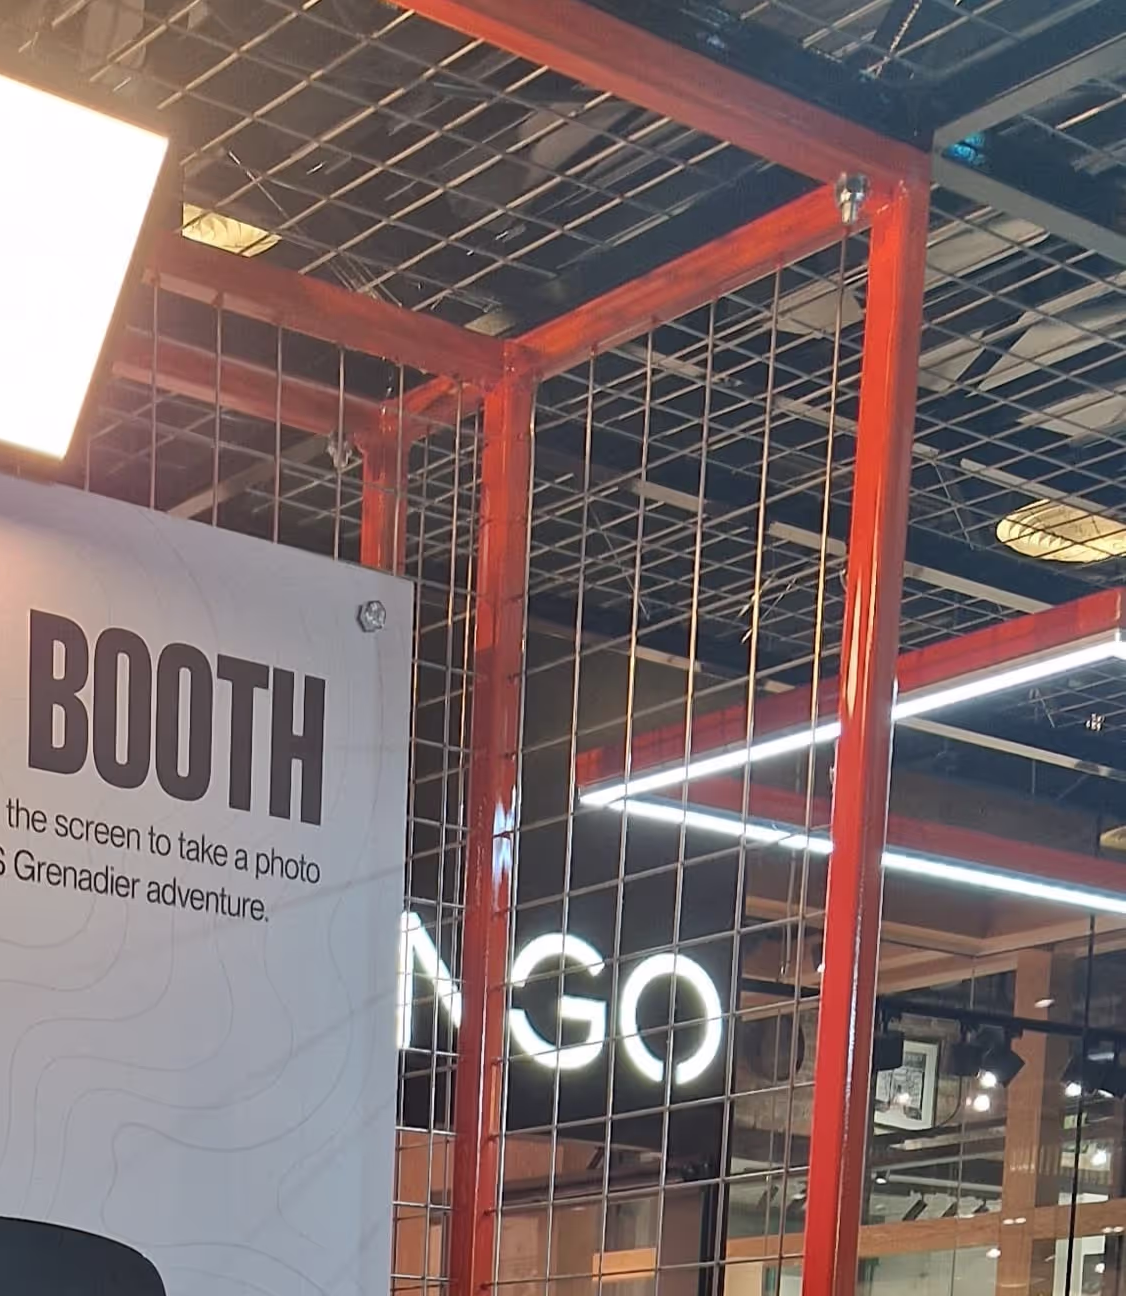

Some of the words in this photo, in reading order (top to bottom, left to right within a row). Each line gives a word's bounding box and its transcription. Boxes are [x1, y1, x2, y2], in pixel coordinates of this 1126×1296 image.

[27, 608, 326, 826] BOOTH
[7, 798, 46, 833] the
[55, 814, 140, 851] screen
[148, 826, 171, 856] to
[179, 832, 228, 867] take
[235, 849, 248, 871] a
[256, 848, 320, 884] photo
[14, 850, 140, 899] Grenadier
[147, 878, 268, 922] adventure.
[397, 911, 724, 1085] NGO
